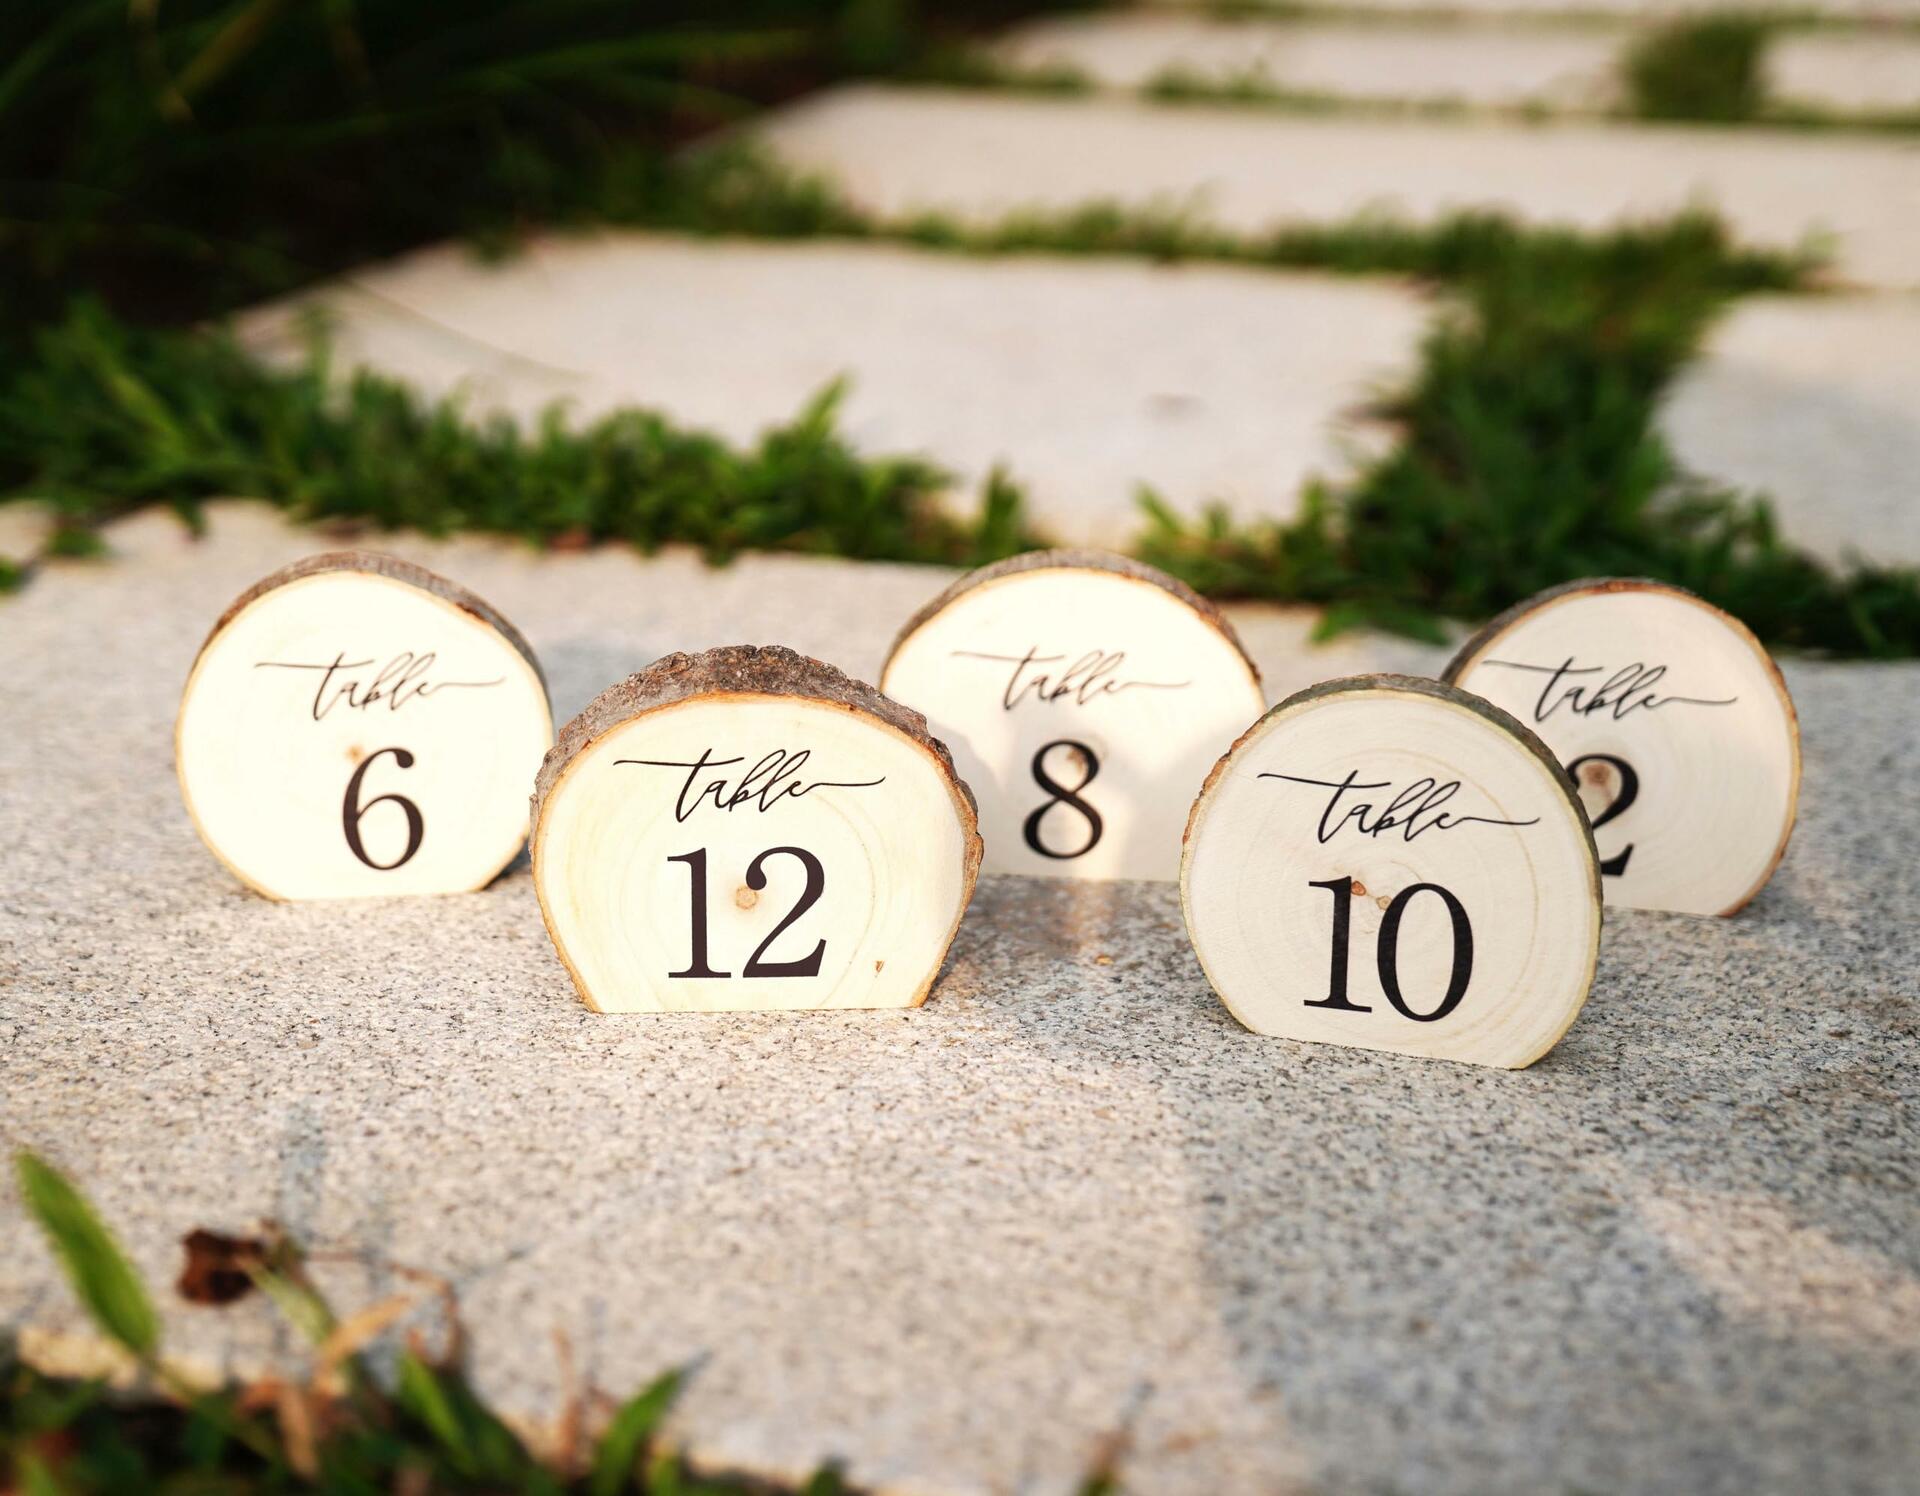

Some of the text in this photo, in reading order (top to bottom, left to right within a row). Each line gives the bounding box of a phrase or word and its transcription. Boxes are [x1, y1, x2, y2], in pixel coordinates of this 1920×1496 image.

[256, 651, 504, 721] table
[952, 646, 1190, 713] table
[1482, 656, 1738, 723] table
[342, 747, 424, 871] 6
[613, 748, 886, 823] table
[1023, 739, 1103, 861] 8
[1257, 769, 1540, 844] table
[1566, 754, 1639, 876] 2
[667, 846, 827, 979] 12
[1303, 875, 1474, 1023] 10
